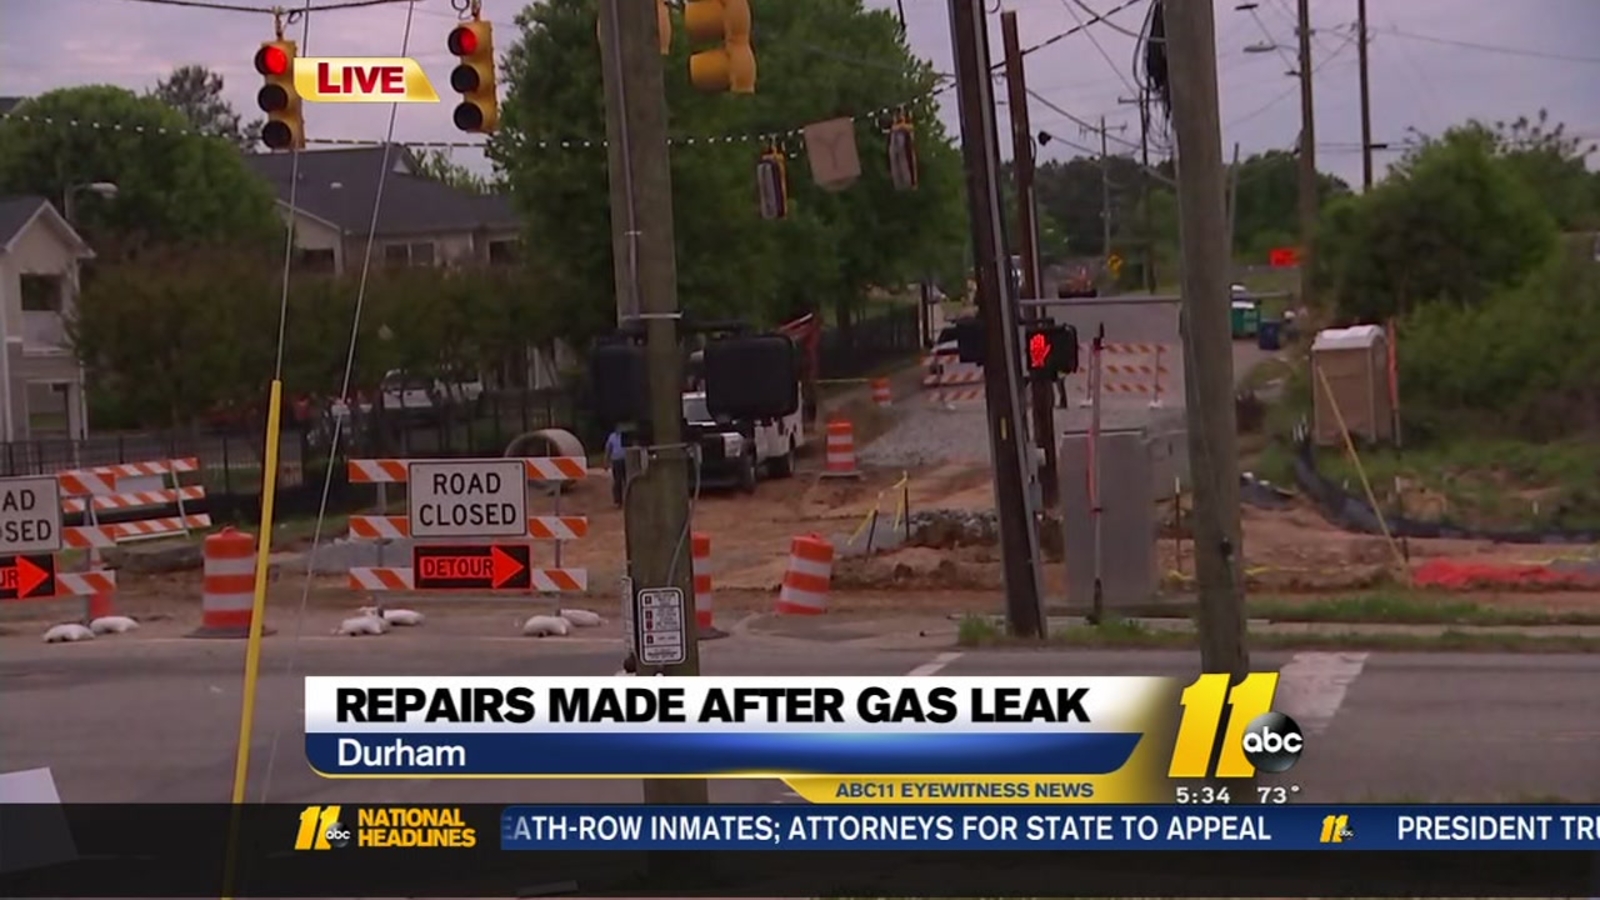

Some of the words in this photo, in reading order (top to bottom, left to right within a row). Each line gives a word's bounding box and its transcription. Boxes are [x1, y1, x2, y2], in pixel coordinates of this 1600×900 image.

[432, 472, 502, 496] ROAD
[419, 503, 517, 527] CLOSED
[0, 519, 52, 543] SED
[423, 558, 495, 577] DETOUR
